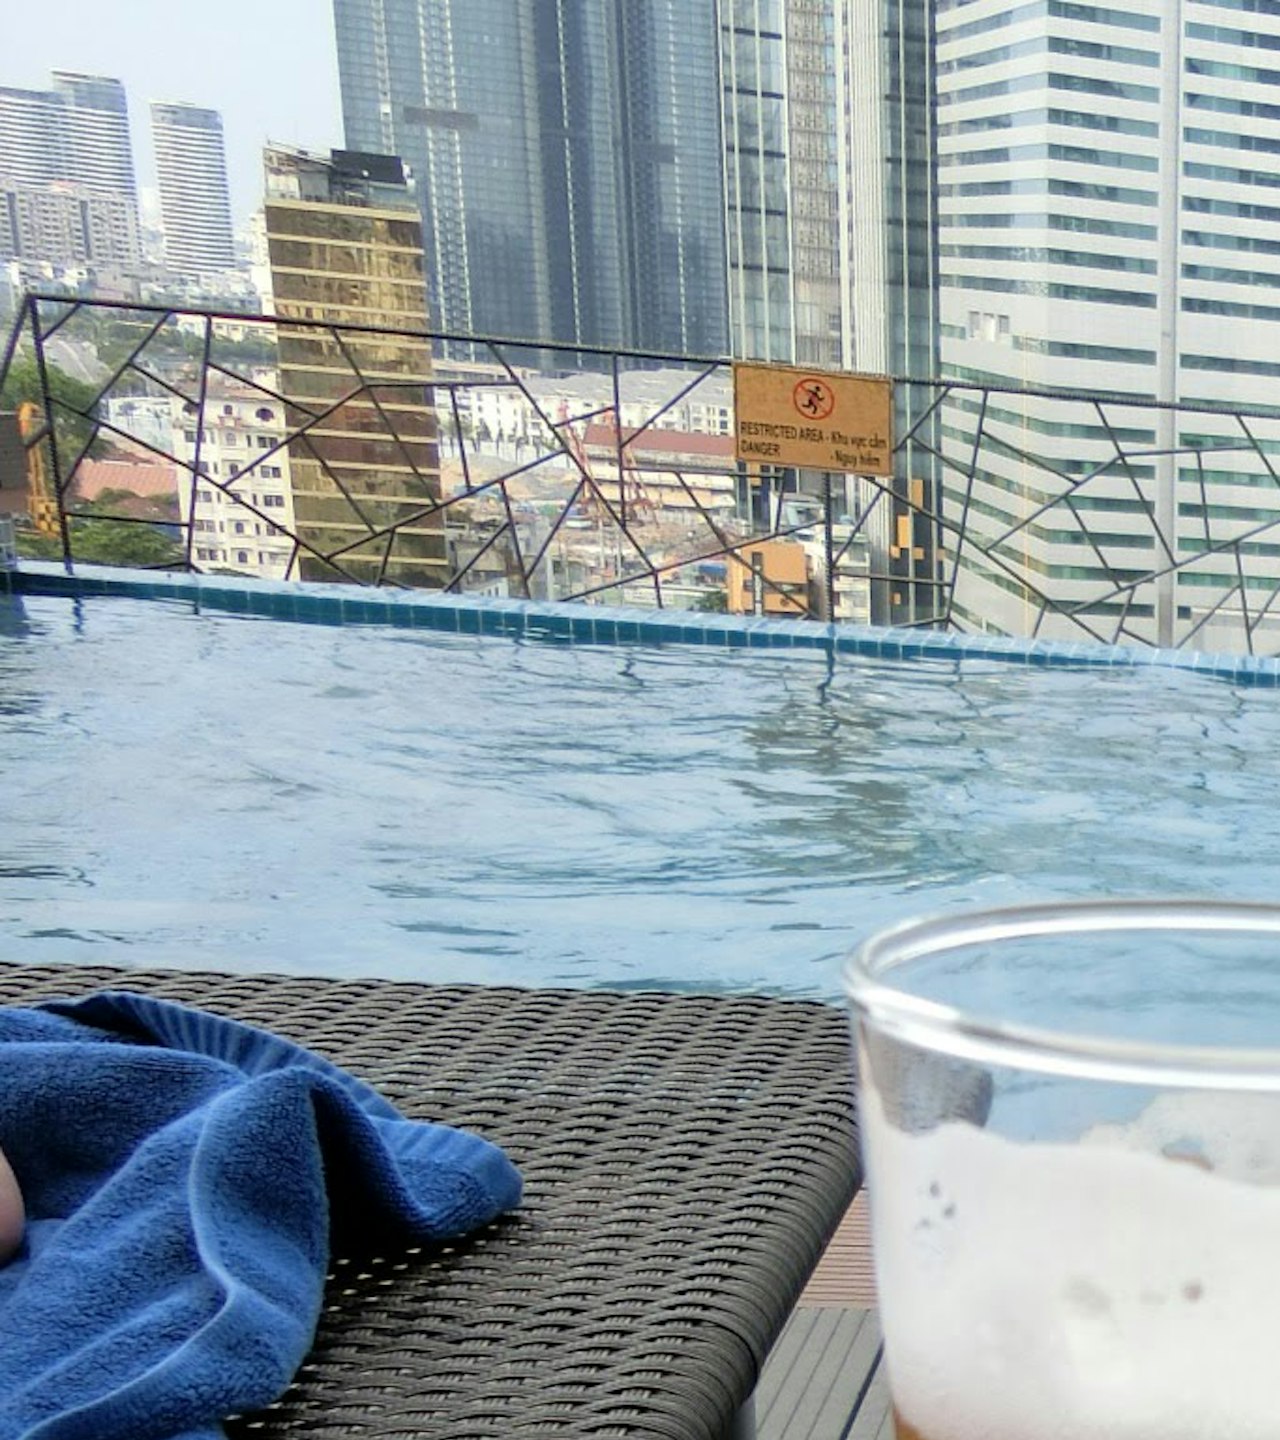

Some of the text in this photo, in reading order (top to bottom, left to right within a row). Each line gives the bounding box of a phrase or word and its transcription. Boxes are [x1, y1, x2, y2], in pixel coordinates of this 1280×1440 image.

[740, 421, 797, 440] RESTRICTED
[799, 427, 824, 443] AREA
[740, 439, 781, 457] DANGER
